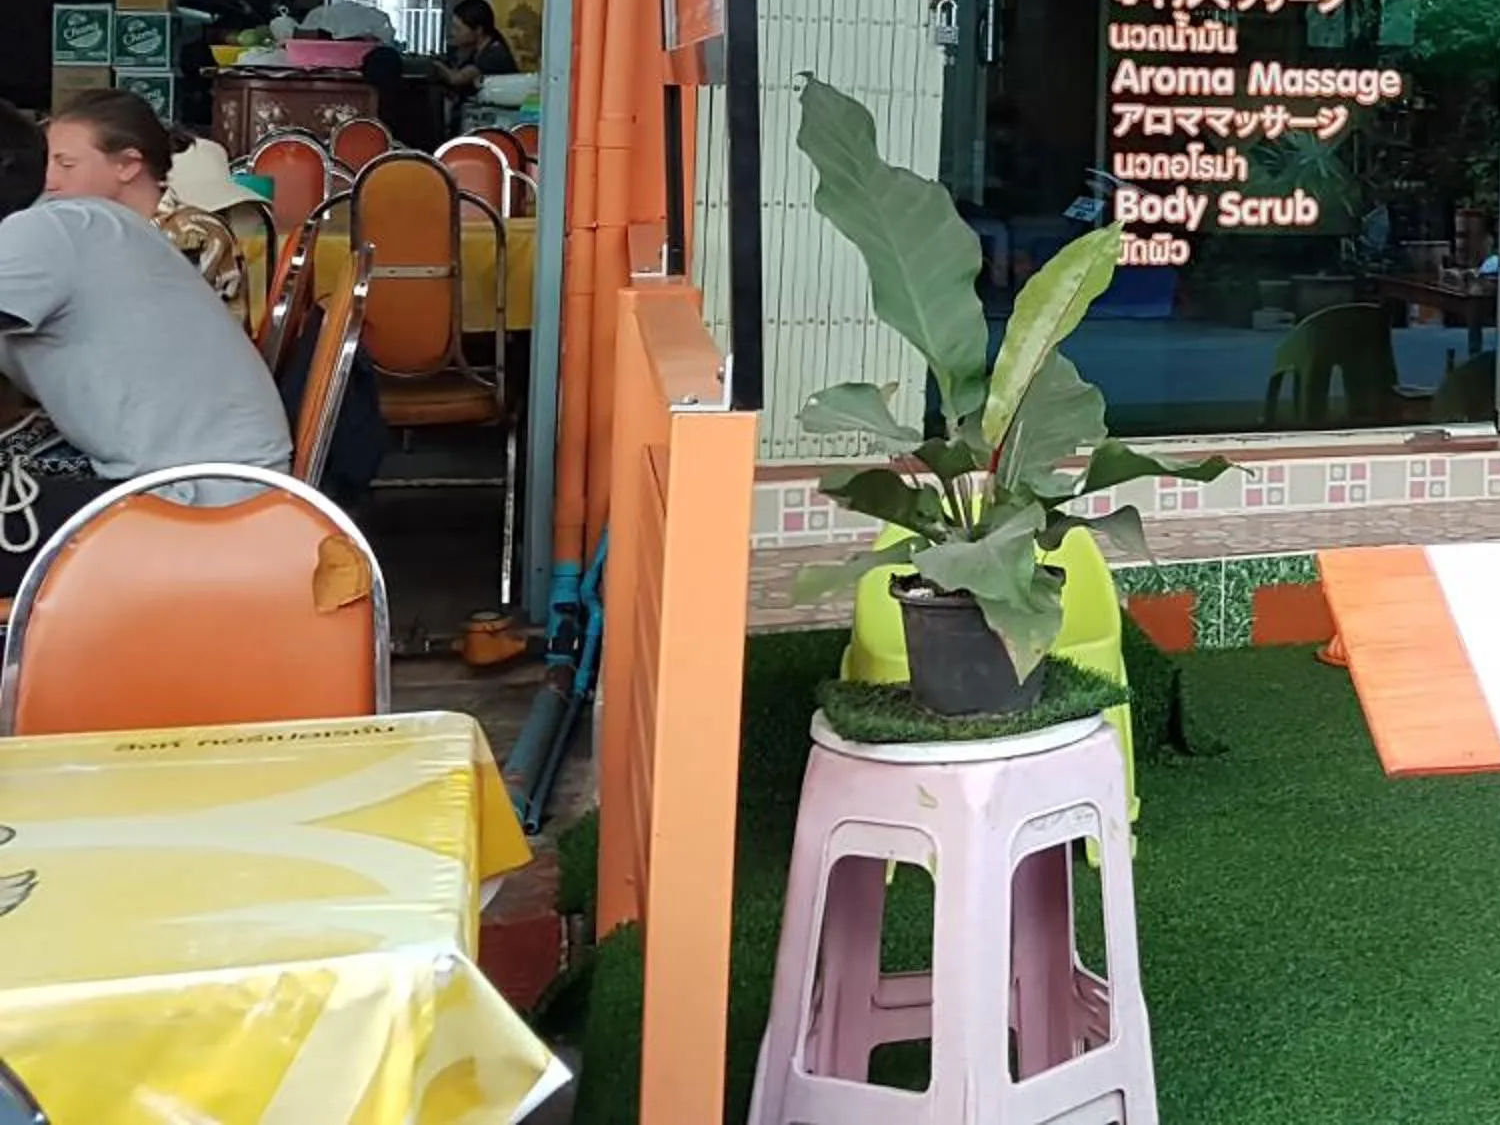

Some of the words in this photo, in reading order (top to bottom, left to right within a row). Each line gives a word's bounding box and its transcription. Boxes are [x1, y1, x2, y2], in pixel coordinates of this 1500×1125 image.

[1109, 11, 1238, 53] นวดน้ำมัน
[1111, 58, 1235, 96] Aroma
[1247, 62, 1402, 106] Massage
[1112, 103, 1349, 139] アロママッサージ
[1113, 185, 1208, 230] Body
[1217, 189, 1319, 225] Scrub
